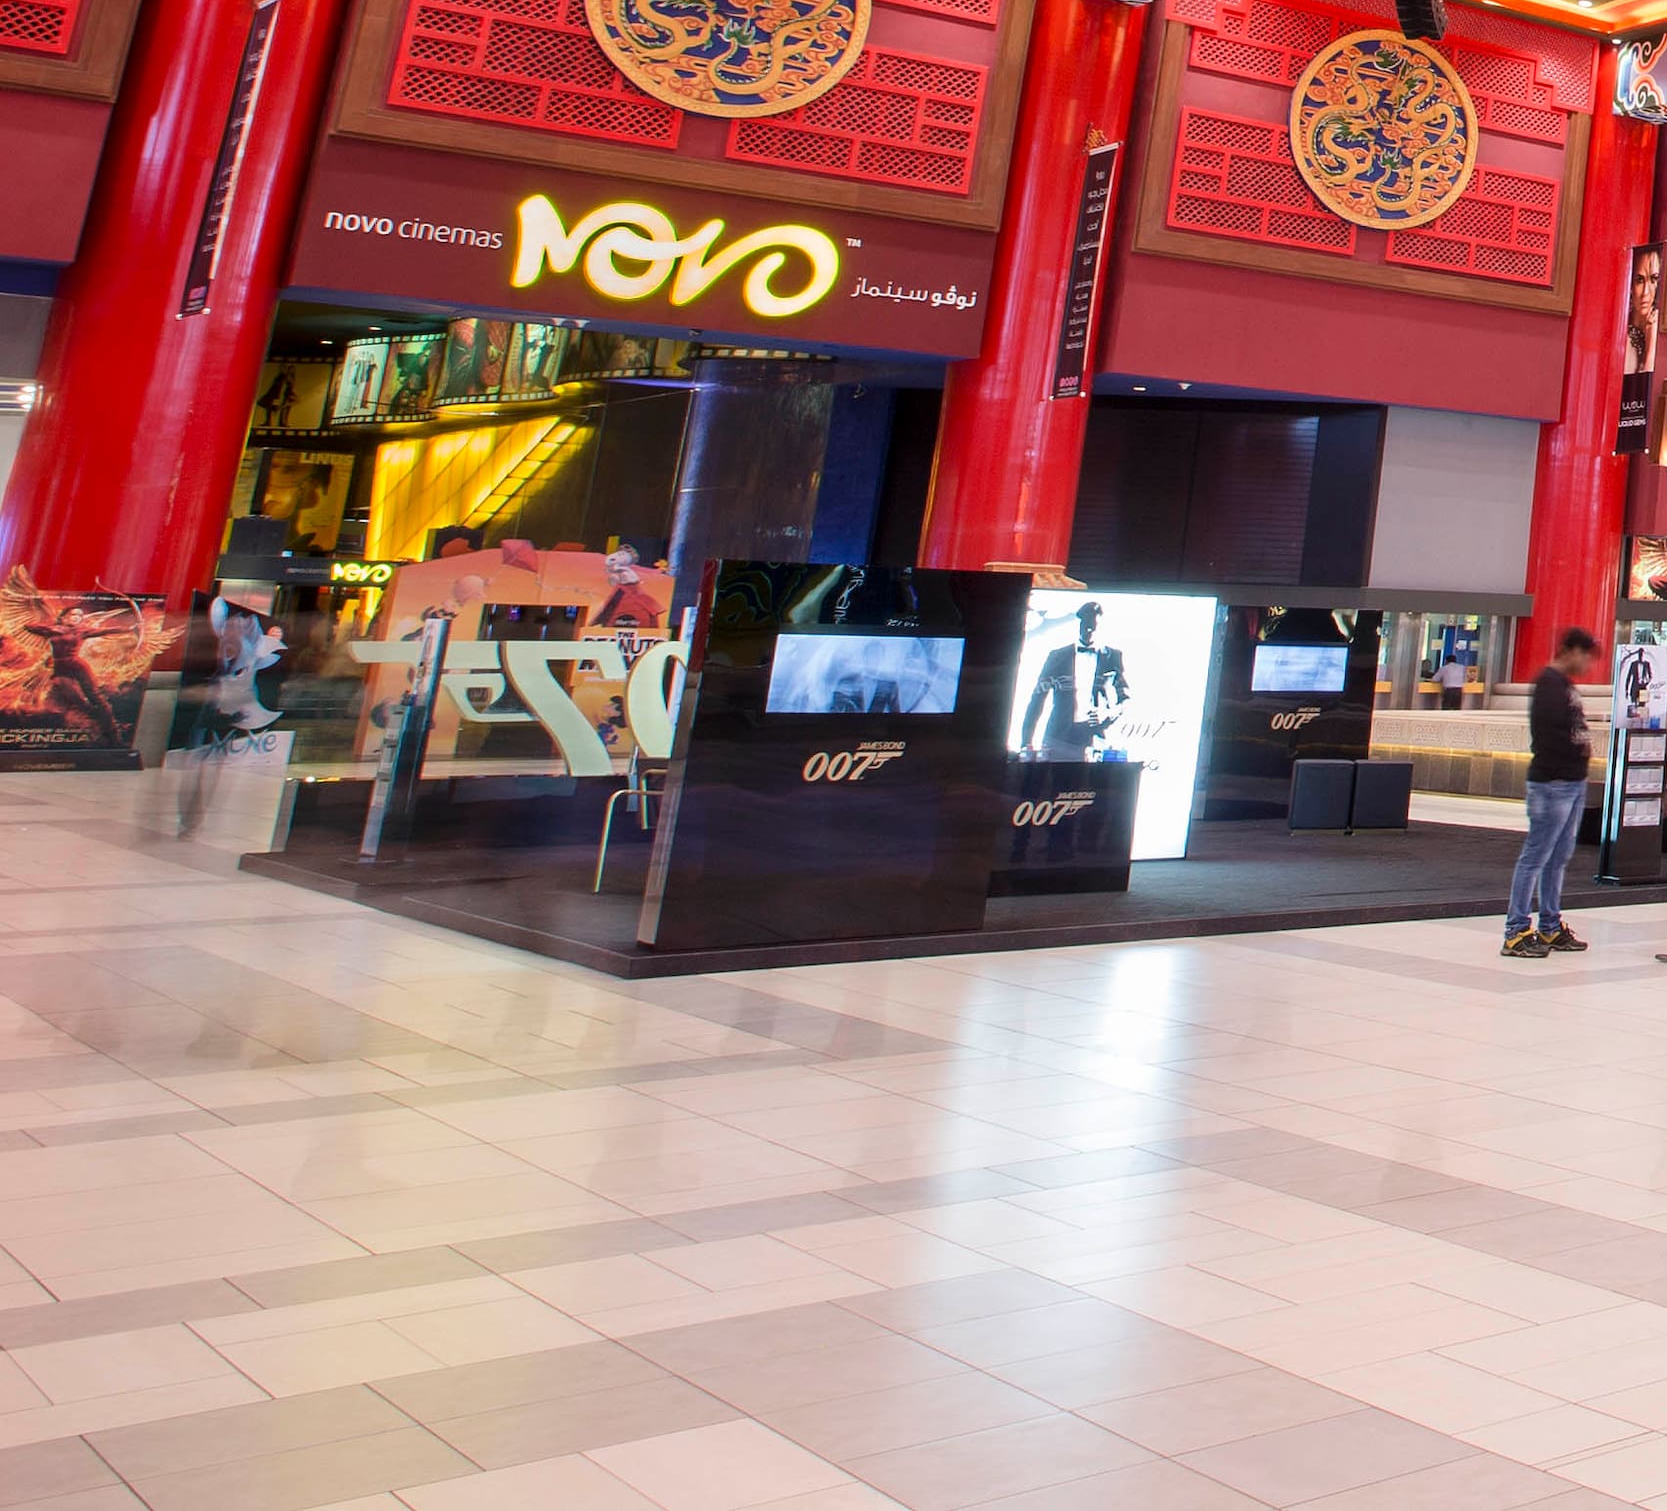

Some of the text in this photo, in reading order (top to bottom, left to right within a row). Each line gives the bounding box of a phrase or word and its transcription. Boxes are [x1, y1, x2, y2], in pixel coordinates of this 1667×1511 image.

[324, 210, 504, 250] novo cinemas
[850, 276, 929, 303] سينماز
[1271, 713, 1310, 730] 007
[0, 733, 95, 743] CKINGJA
[802, 751, 884, 782] 007
[1011, 800, 1080, 827] 007
